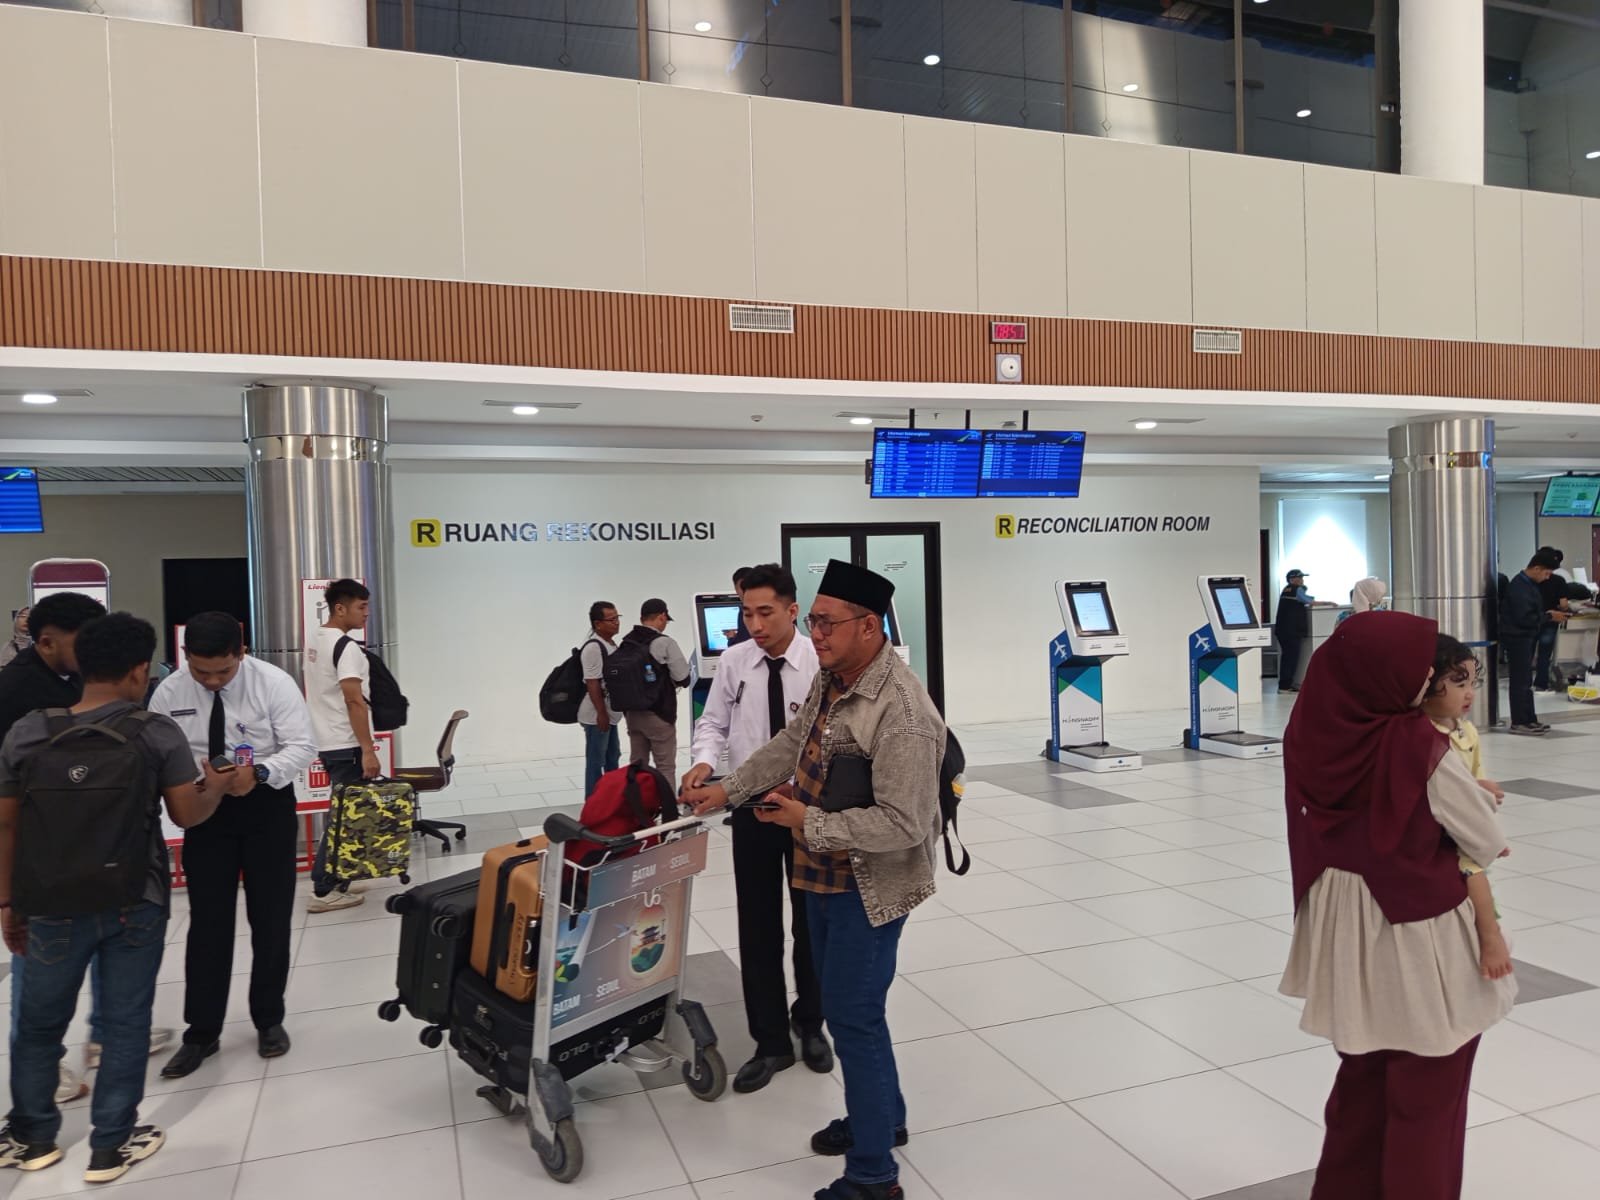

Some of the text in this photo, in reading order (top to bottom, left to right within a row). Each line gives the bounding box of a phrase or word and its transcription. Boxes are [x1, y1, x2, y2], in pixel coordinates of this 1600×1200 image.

[416, 522, 436, 543] R
[444, 521, 715, 543] RUANG REKONSILIASI
[998, 518, 1012, 535] R
[1017, 516, 1210, 534] RECONCILIATION ROOM
[631, 863, 657, 883] BATAM
[552, 978, 620, 1016] BATAM SEOUL
